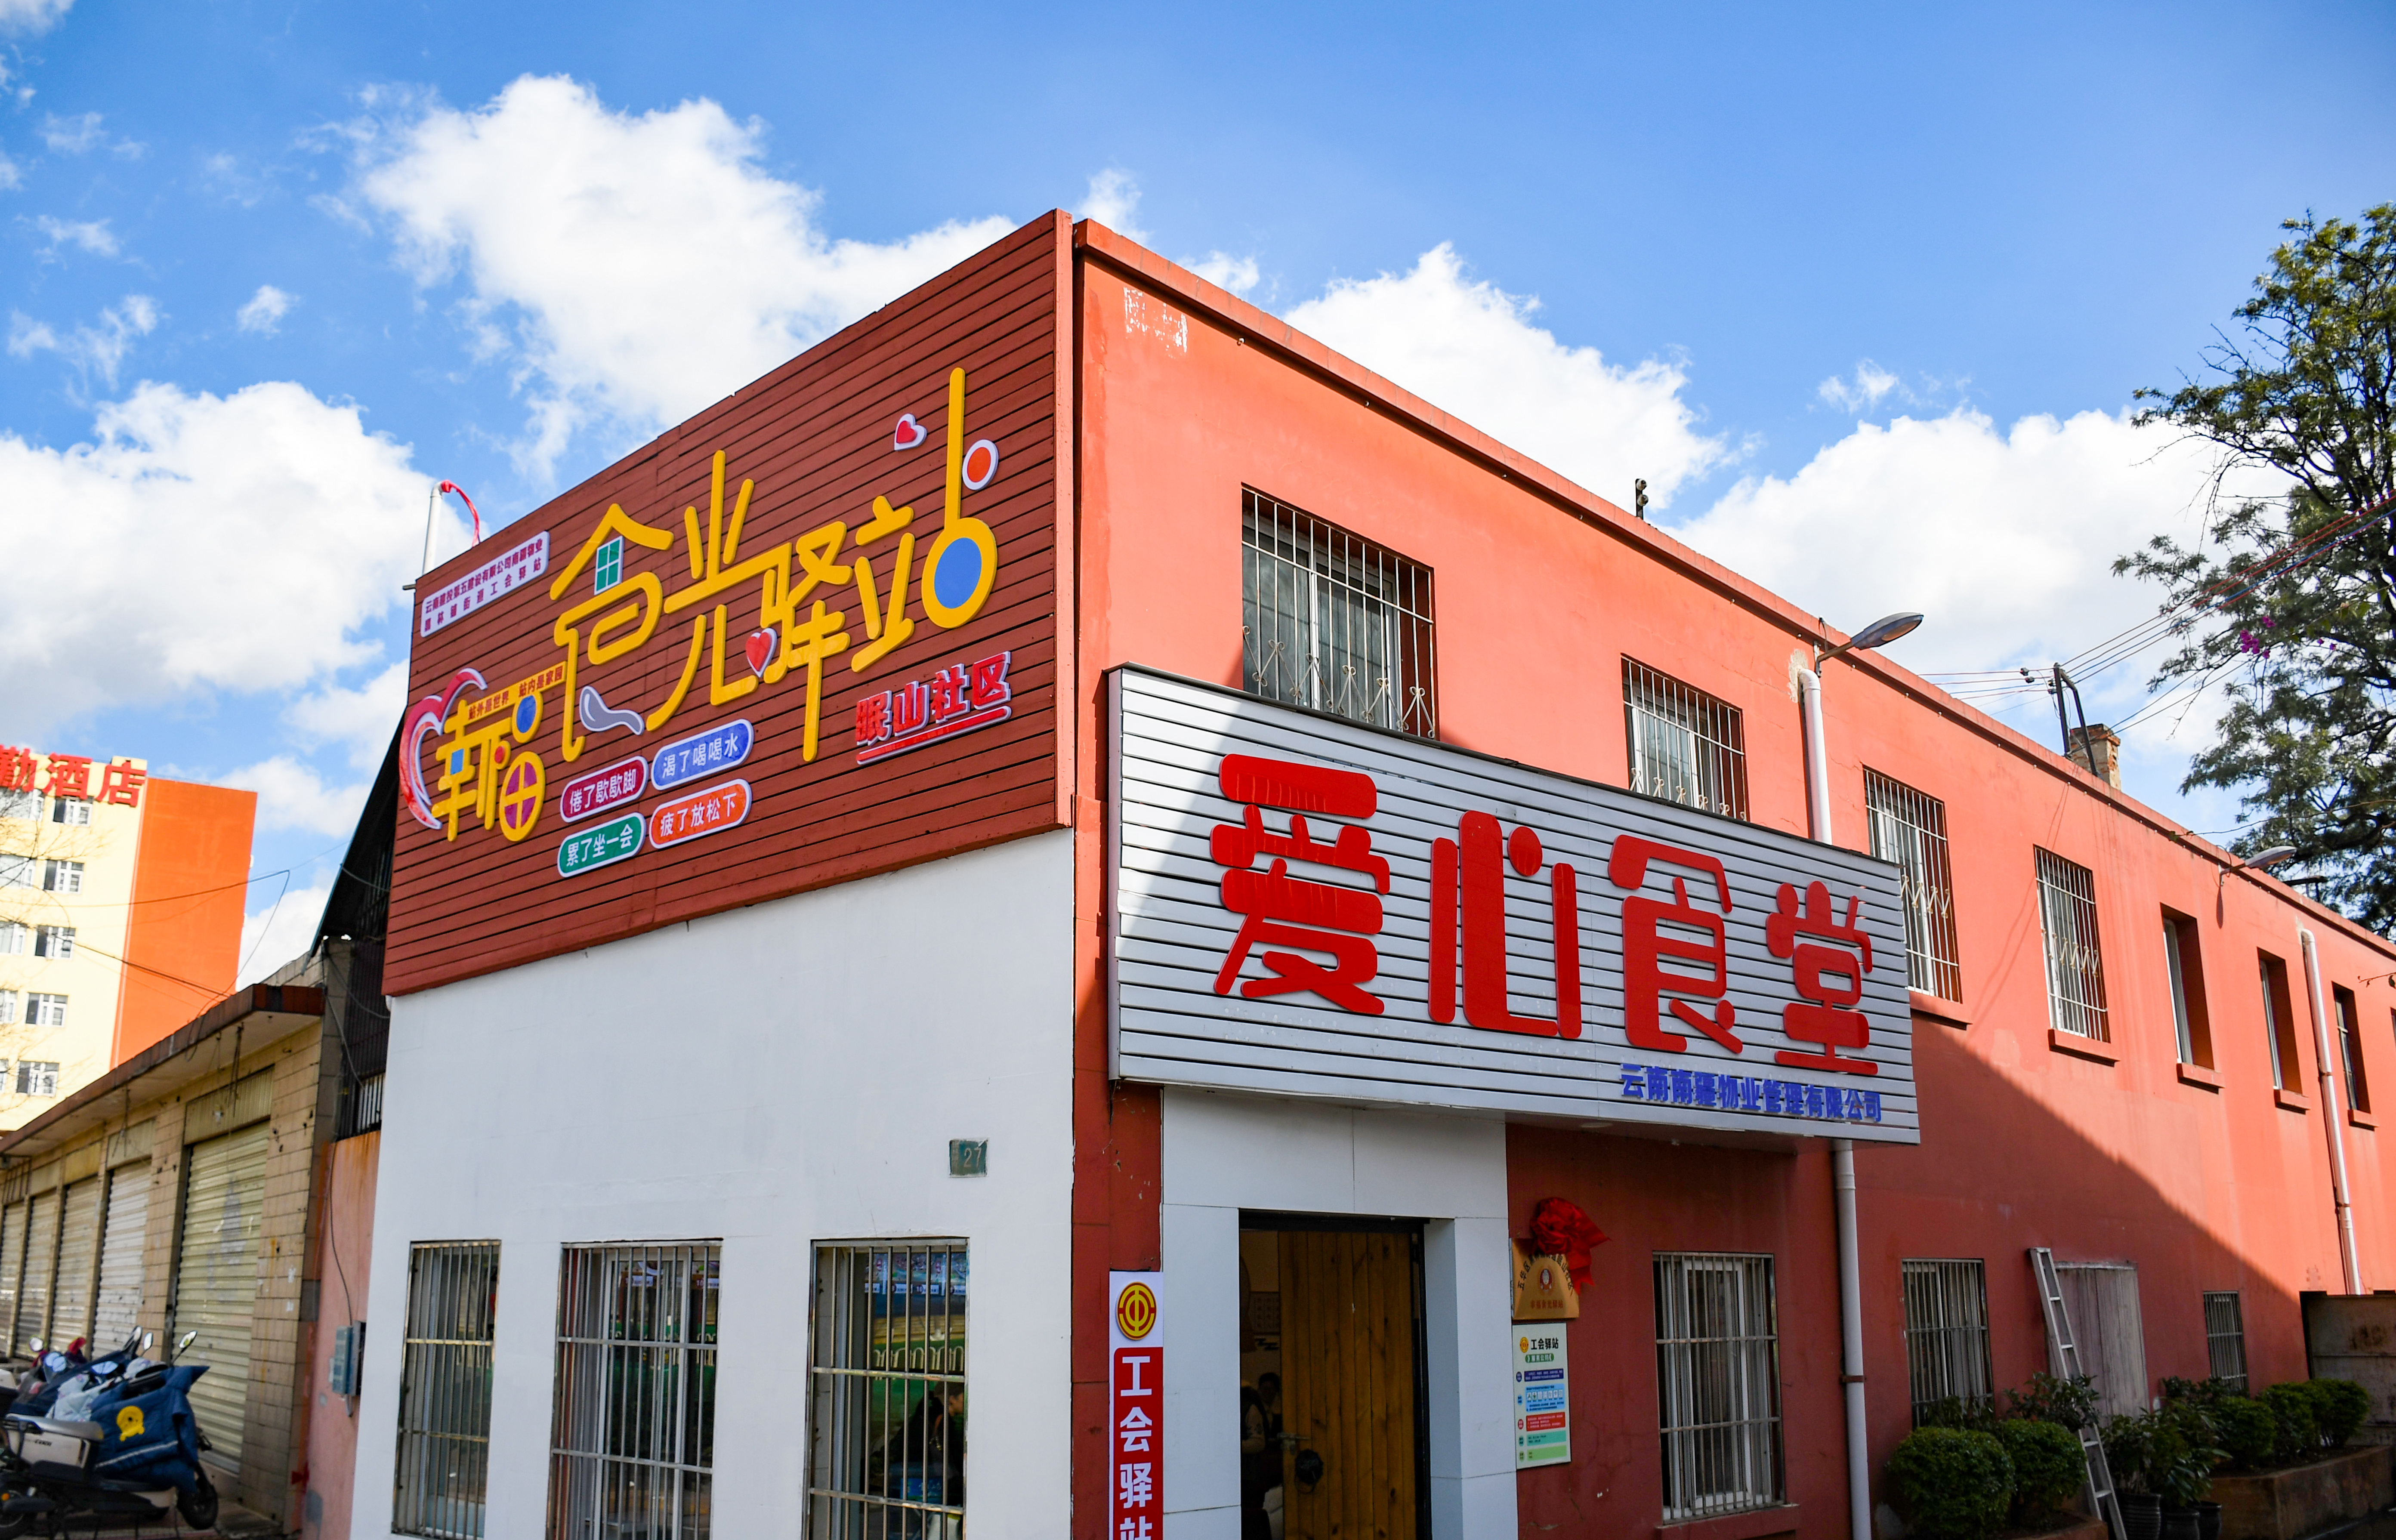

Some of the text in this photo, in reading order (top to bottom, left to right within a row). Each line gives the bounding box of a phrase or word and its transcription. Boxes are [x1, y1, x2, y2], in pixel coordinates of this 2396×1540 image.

[468, 666, 563, 720] 站外是世界 站内是家园
[855, 651, 1012, 746] 眠山社区
[662, 733, 739, 779] 渴了喝喝水
[569, 768, 636, 814] 倦了歇歇脚
[660, 792, 737, 838] 疲了放松下
[566, 823, 634, 867] 累了坐一会
[1210, 753, 1879, 1076] 爱心食堂
[1620, 1063, 1882, 1122] 云南南疆物业管理有限公司
[963, 1148, 982, 1168] 27
[1531, 1337, 1559, 1350] 工会驿站
